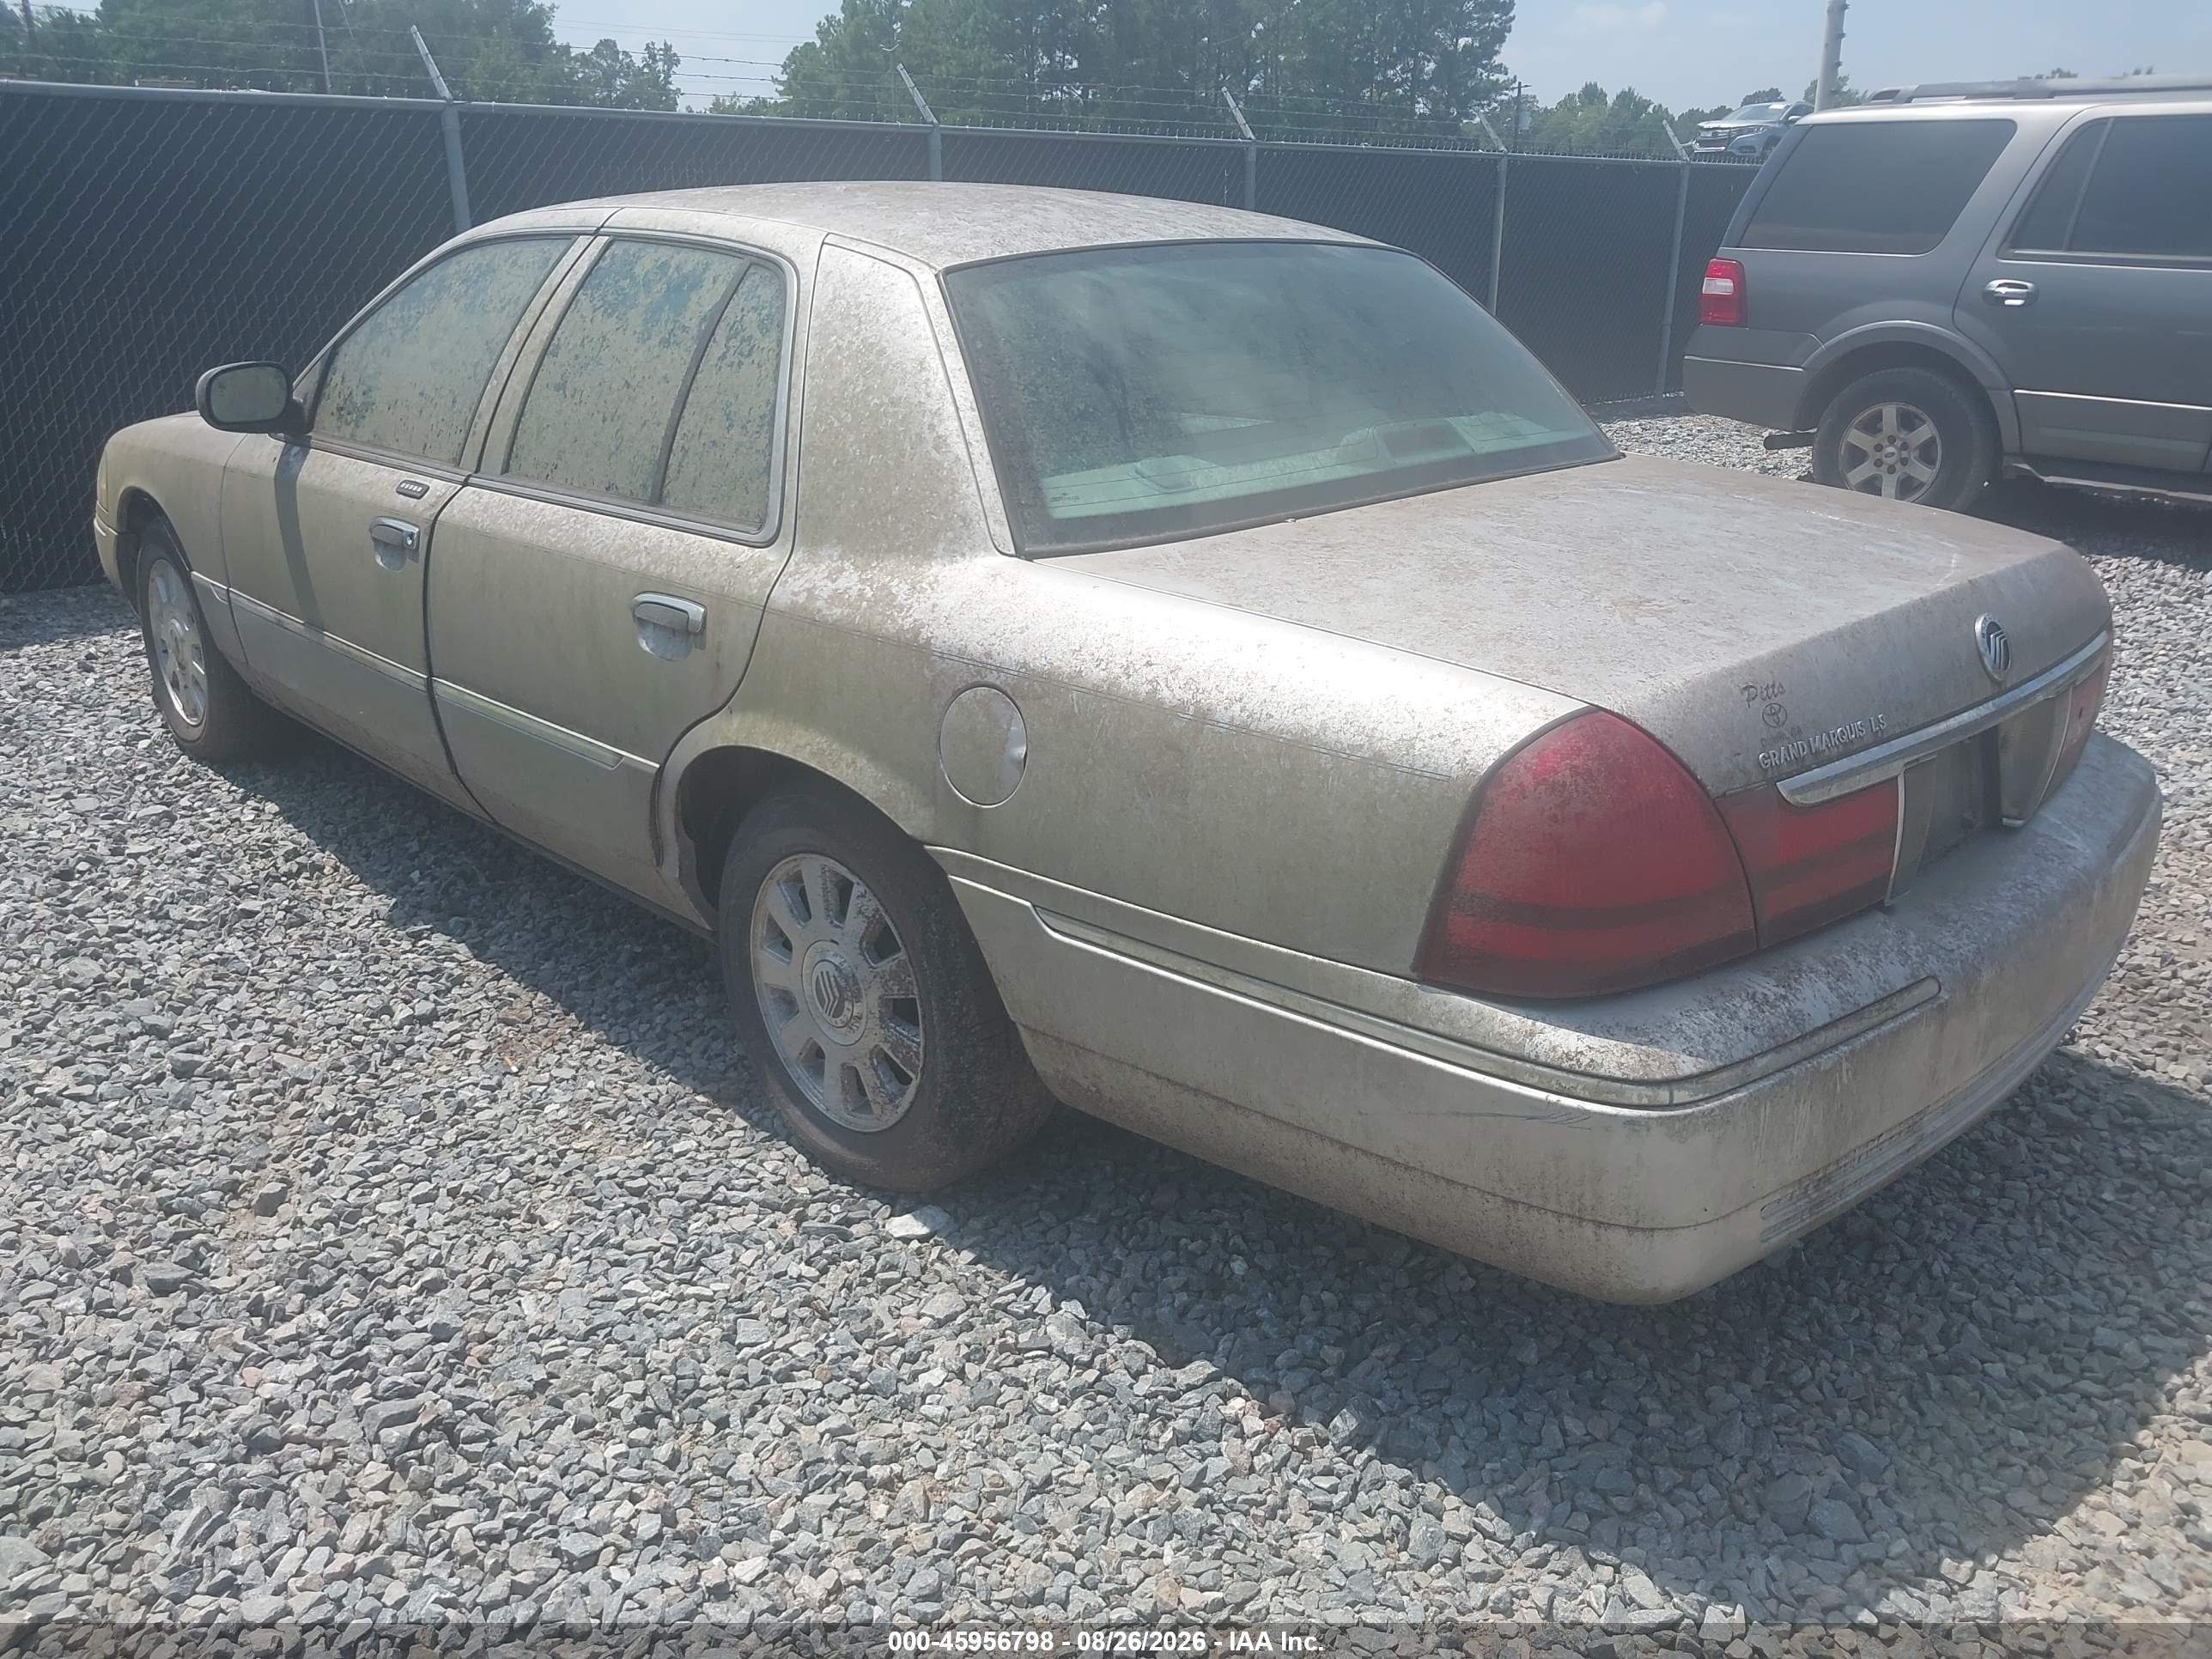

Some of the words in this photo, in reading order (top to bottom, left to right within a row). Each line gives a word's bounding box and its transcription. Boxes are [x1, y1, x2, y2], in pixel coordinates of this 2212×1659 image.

[1759, 739, 1808, 769] GRAND
[1808, 720, 1866, 754] MARQUIS
[1869, 714, 1887, 732] LS
